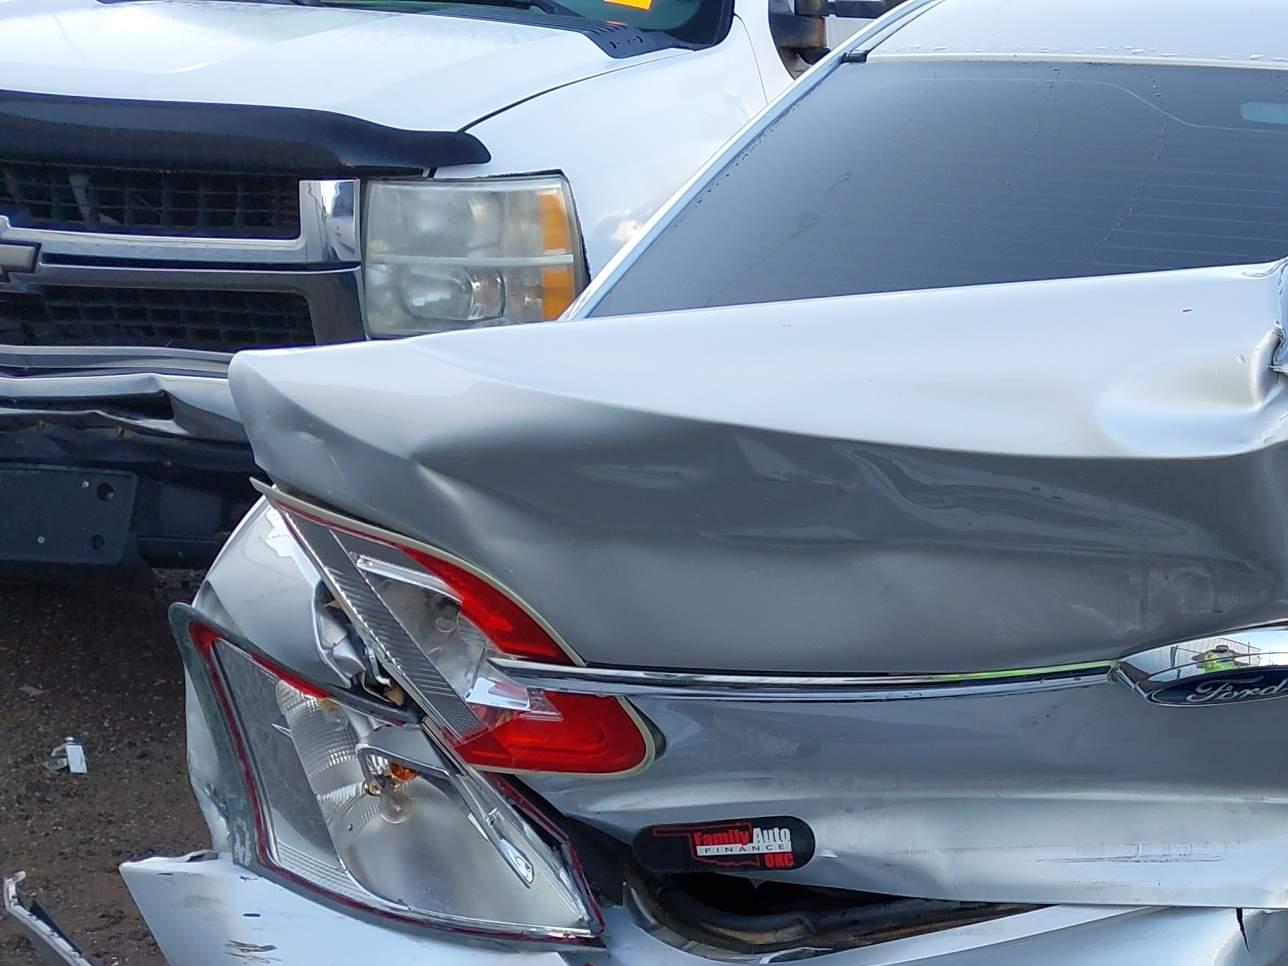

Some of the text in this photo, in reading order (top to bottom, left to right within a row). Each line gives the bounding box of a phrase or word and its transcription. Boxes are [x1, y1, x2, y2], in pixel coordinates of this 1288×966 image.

[694, 827, 791, 846] Family Auto
[704, 843, 785, 854] FINANCE
[764, 853, 794, 868] OKC
